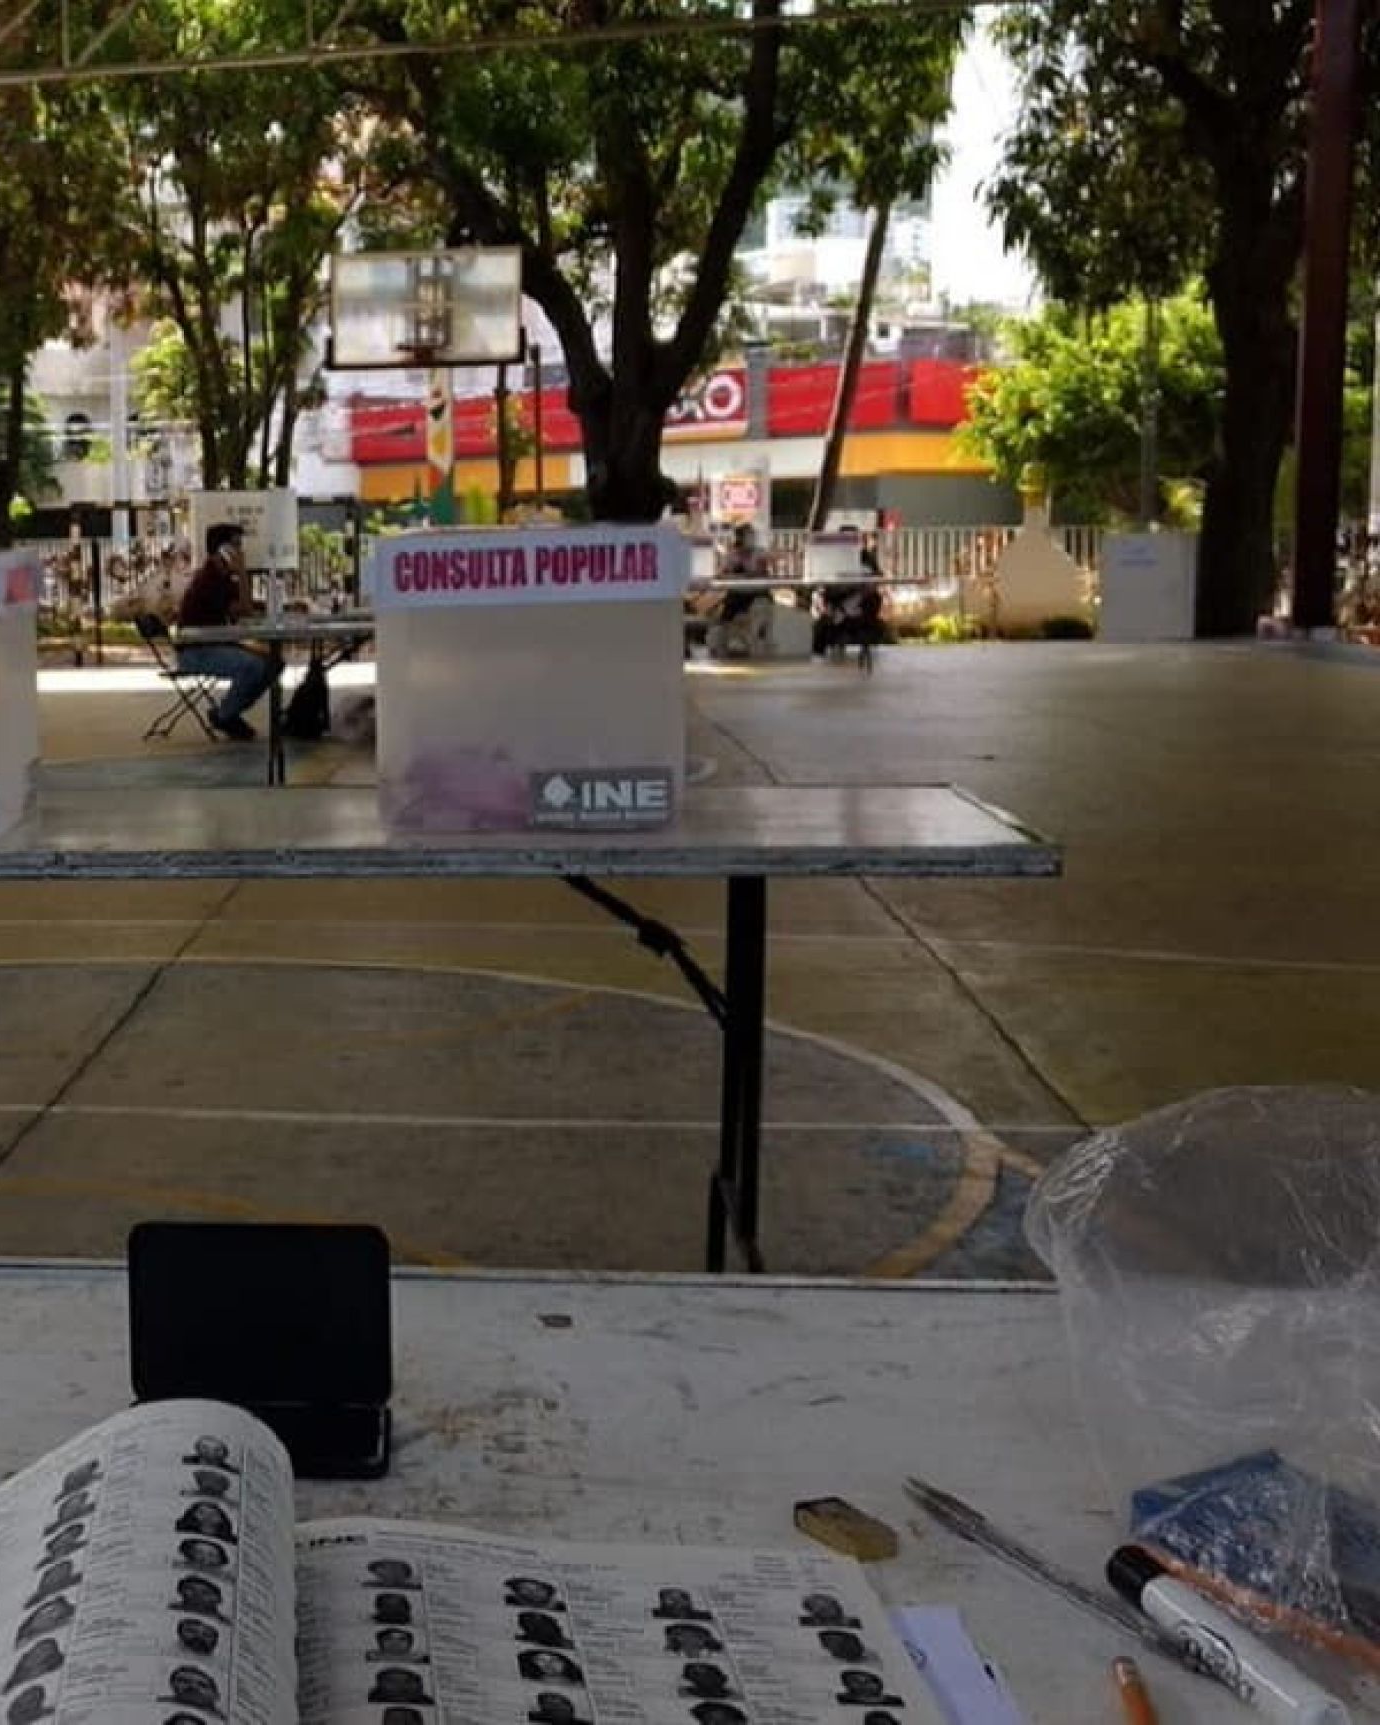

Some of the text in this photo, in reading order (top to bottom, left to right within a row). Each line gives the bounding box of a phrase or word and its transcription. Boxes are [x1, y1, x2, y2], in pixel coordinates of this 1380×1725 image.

[394, 542, 659, 593] CONSULTA POPULAR
[581, 779, 668, 809] INE
